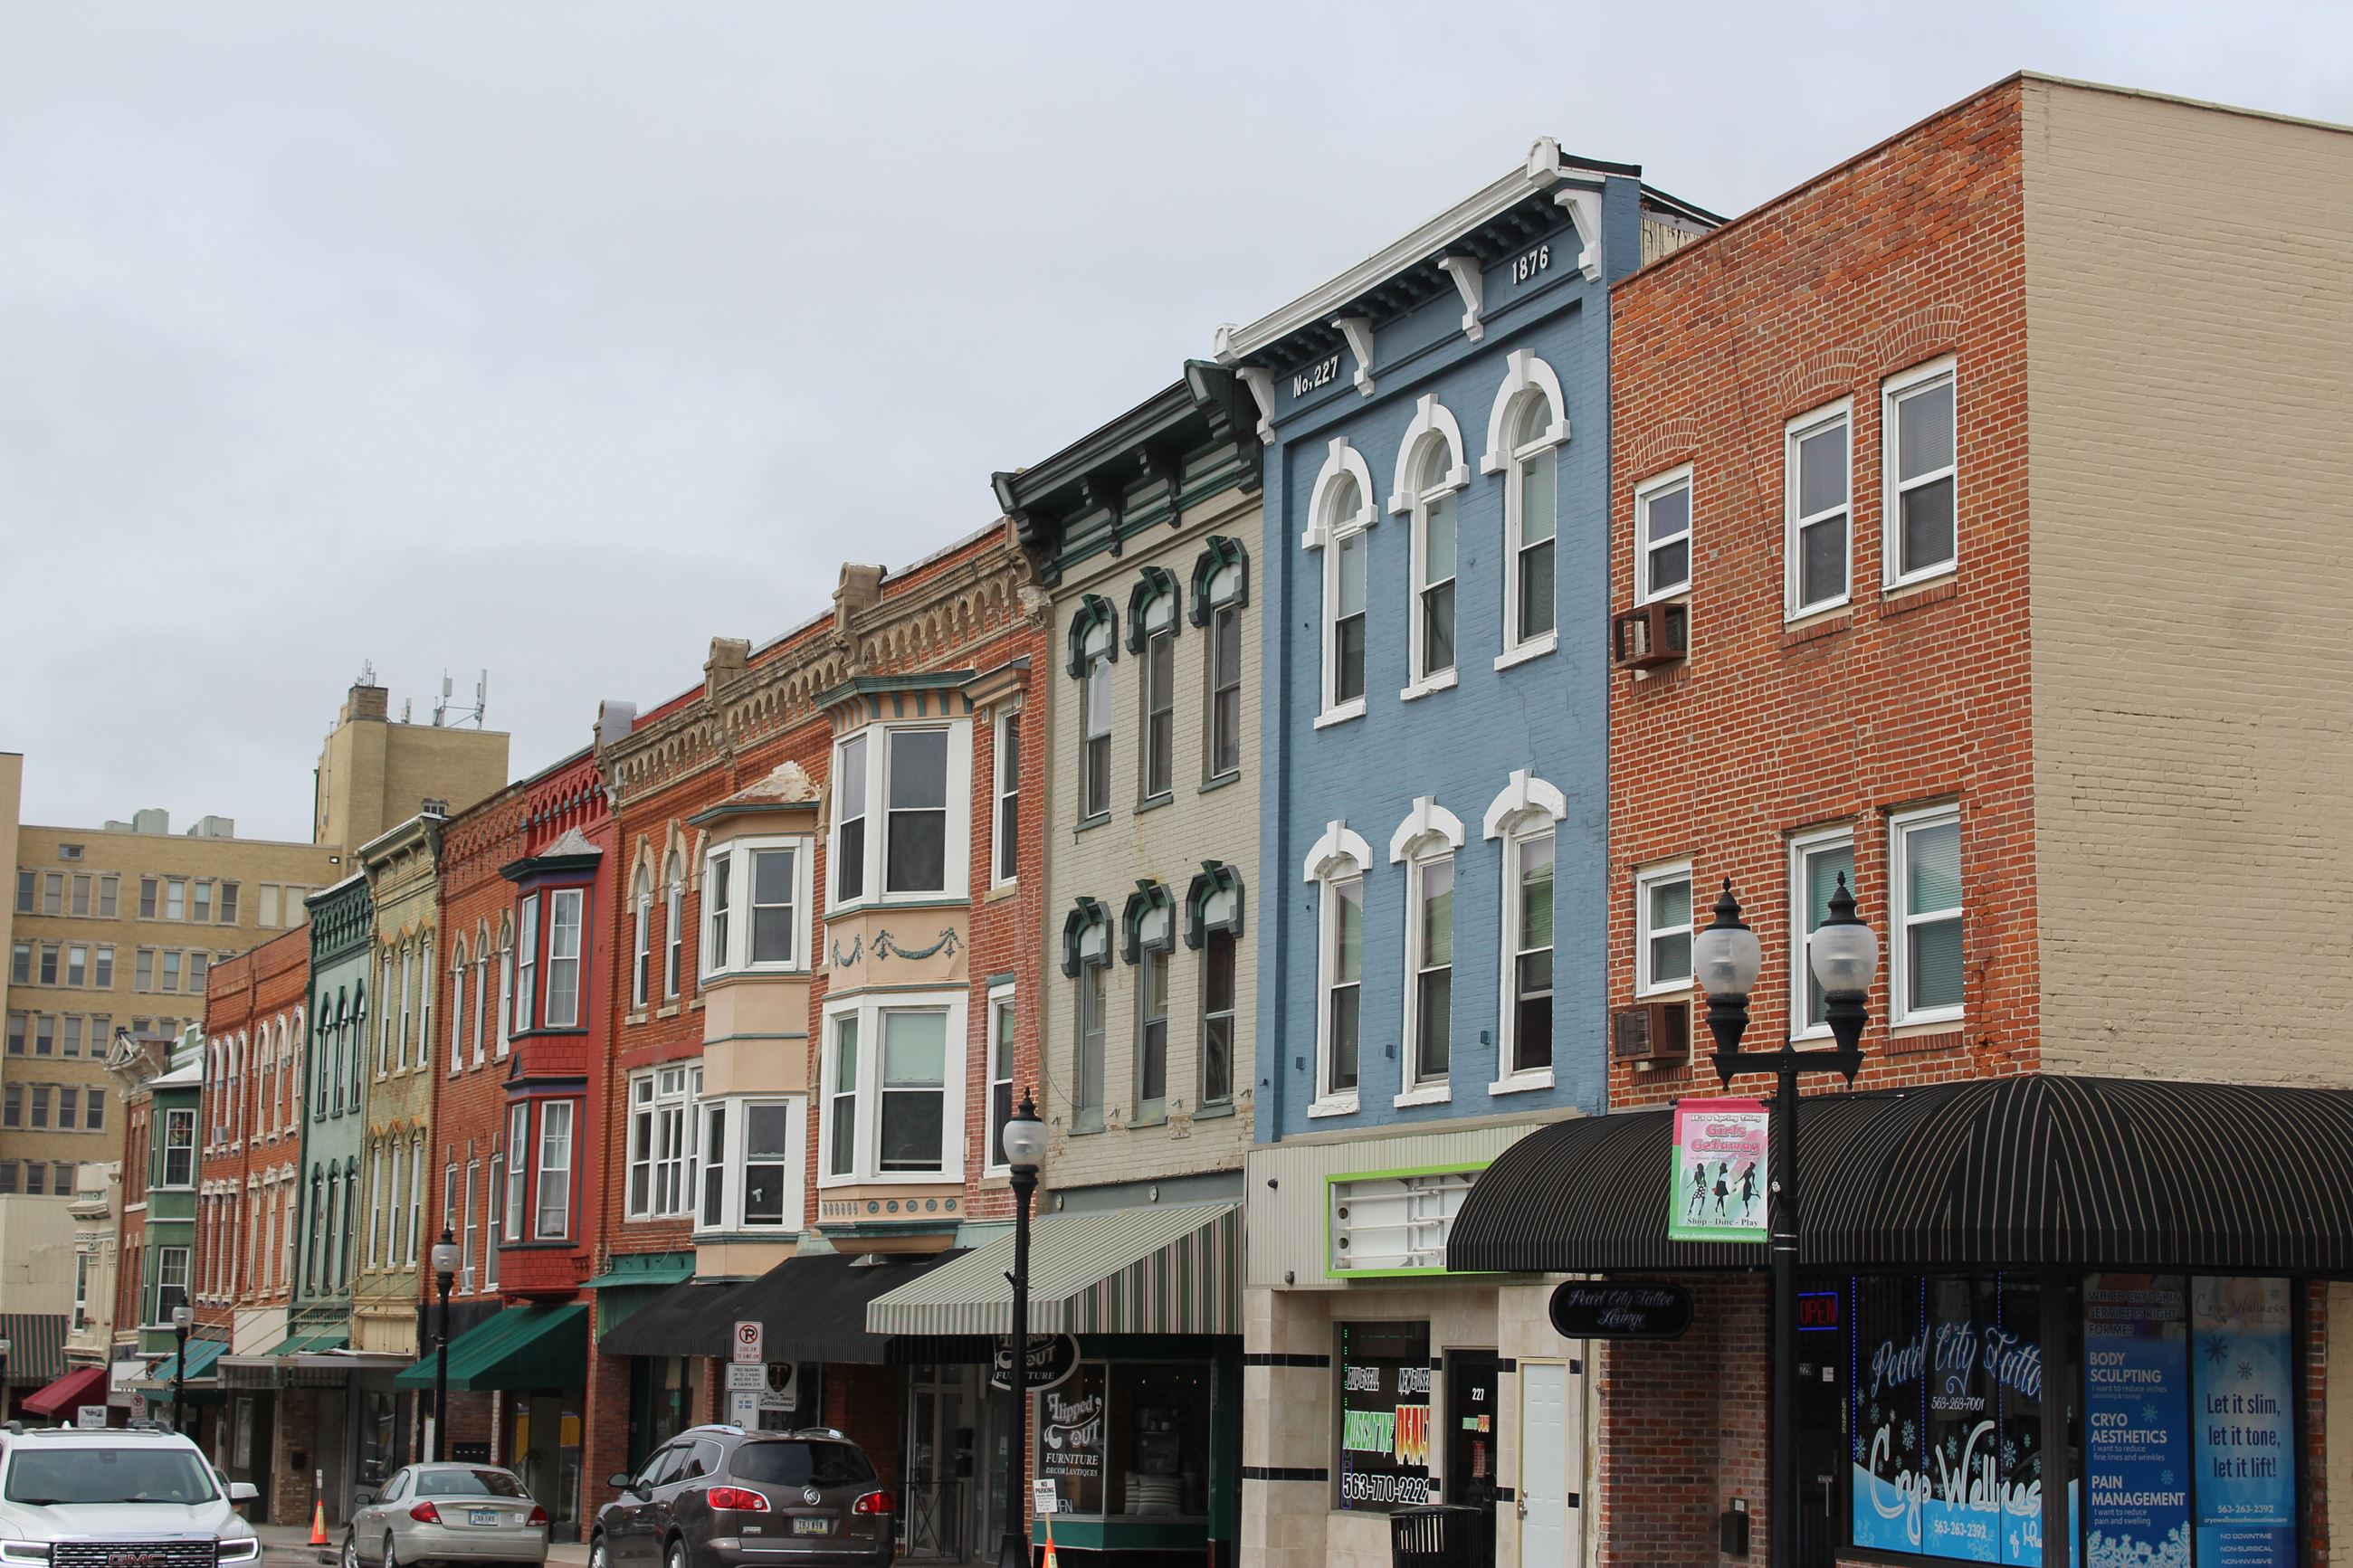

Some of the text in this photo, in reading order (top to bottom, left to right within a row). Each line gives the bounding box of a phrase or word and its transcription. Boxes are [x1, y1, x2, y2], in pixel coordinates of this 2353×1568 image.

[1512, 245, 1548, 285] 1876
[1713, 1115, 1739, 1123] Spring
[1739, 1115, 1761, 1123] Thing
[1705, 1124, 1747, 1137] Girls
[1691, 1138, 1760, 1155] Getaway
[1687, 1217, 1708, 1227] Shop
[1715, 1218, 1734, 1226] Dine
[1741, 1218, 1758, 1227] Play
[1568, 1288, 1606, 1307] Pearl
[1607, 1288, 1633, 1311] City
[2089, 1290, 2182, 1304] WHICH CRYOSKIN
[1799, 1298, 1836, 1324] OPEN
[2089, 1307, 2177, 1320] SERVICE IS RIGHT
[1597, 1308, 1646, 1331] Lounge
[2089, 1324, 2135, 1336] FOR ME?
[1871, 1323, 1930, 1399] Pearl
[1935, 1319, 1977, 1396] City
[2090, 1352, 2125, 1365] BODY
[2090, 1368, 2162, 1383] SCULPTING
[1472, 1387, 1484, 1401] 227
[2146, 1385, 2167, 1393] inches
[1931, 1396, 1985, 1411] 563-263-7001
[2206, 1393, 2281, 1417] Let it slim,
[2091, 1412, 2128, 1427] CRYO
[1343, 1410, 1396, 1459] MUSCATINE
[2091, 1430, 2167, 1444] AESTHETICS
[2208, 1425, 2281, 1449] let it tone,
[1045, 1452, 1099, 1466] FURNITURE
[2093, 1453, 2166, 1461] fine lines and wrinkles
[1068, 1468, 1098, 1478] ANTIQUES
[2214, 1457, 2276, 1478] let it lift!
[1870, 1422, 1932, 1546] Cryo
[2091, 1475, 2123, 1489] PAIN
[2091, 1492, 2186, 1506] MANAGEMENT
[2217, 1505, 2274, 1514] 563-263-2392
[2094, 1517, 2109, 1526] pain
[2124, 1516, 2151, 1526] swelling
[1934, 1519, 1987, 1539] 563-263-2392
[109, 1554, 167, 1565] GMC
